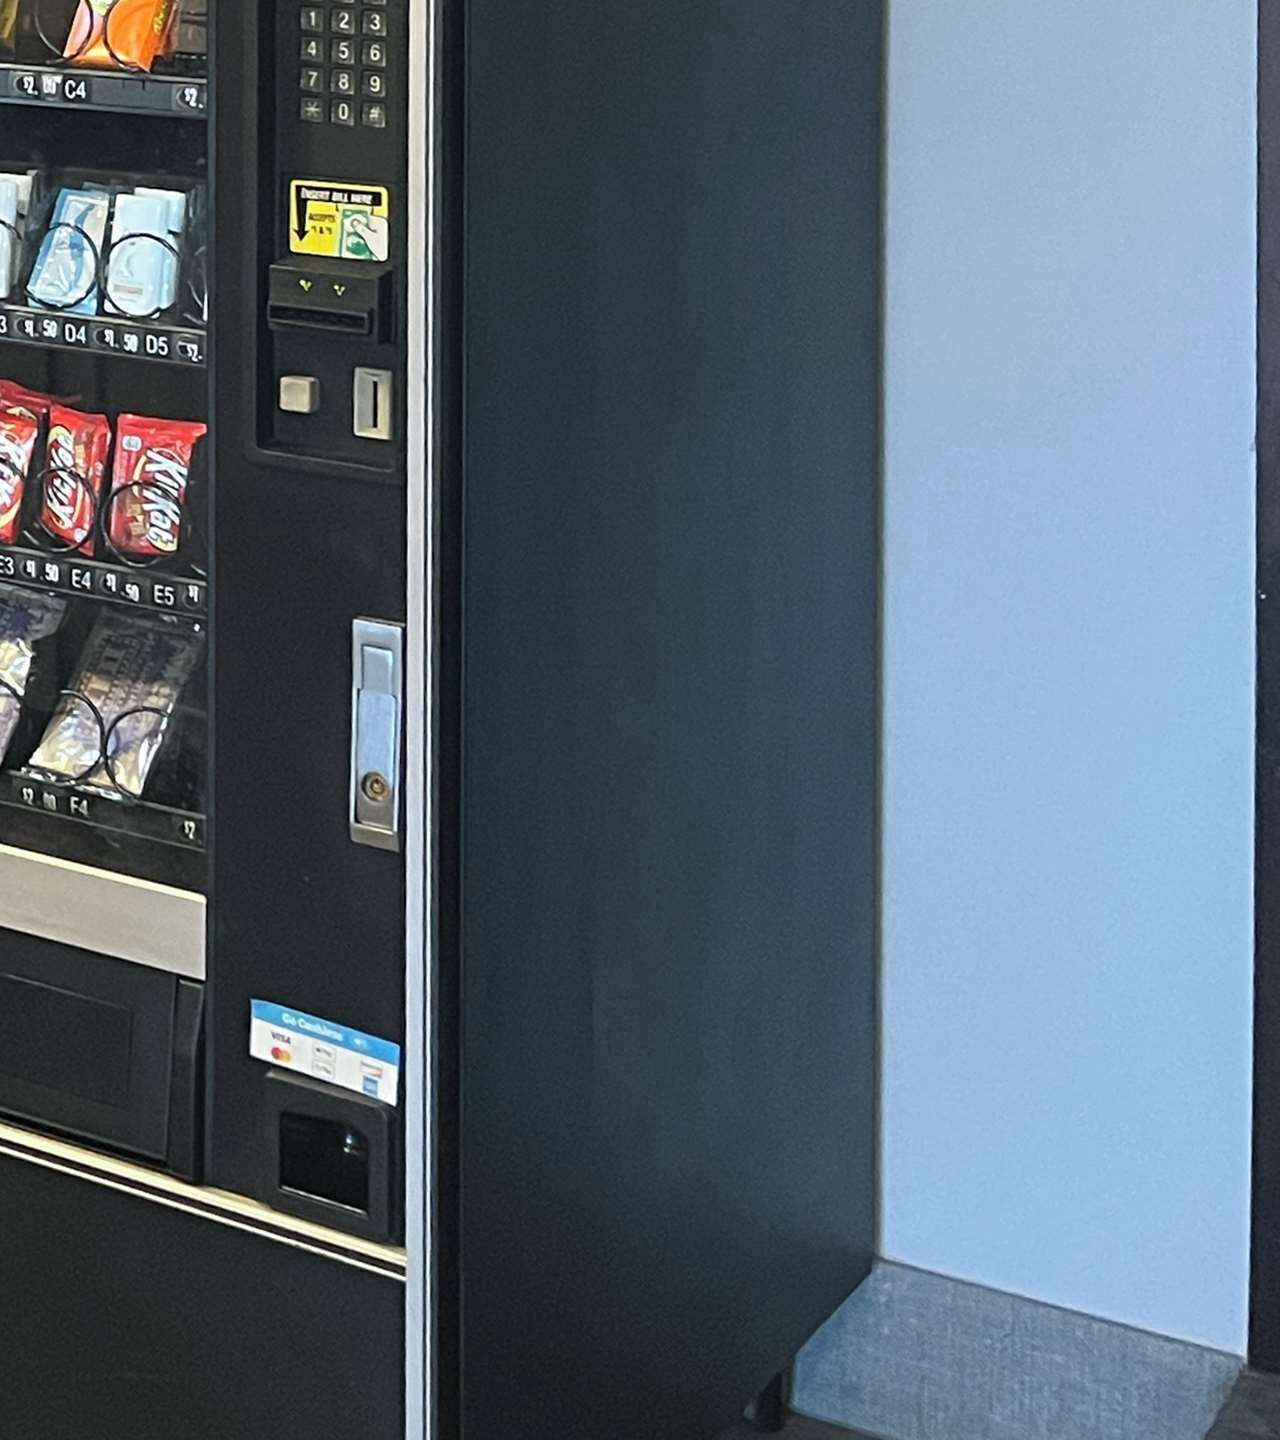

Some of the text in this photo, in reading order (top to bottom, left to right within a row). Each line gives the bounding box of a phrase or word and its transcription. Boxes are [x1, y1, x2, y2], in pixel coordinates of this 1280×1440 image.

[64, 79, 86, 99] C4
[65, 323, 87, 344] D4
[146, 334, 169, 355] D5
[71, 565, 91, 585] E4
[154, 585, 175, 605] E5
[69, 796, 89, 816] F4
[281, 1012, 297, 1025] Go
[270, 1031, 292, 1045] VISA
